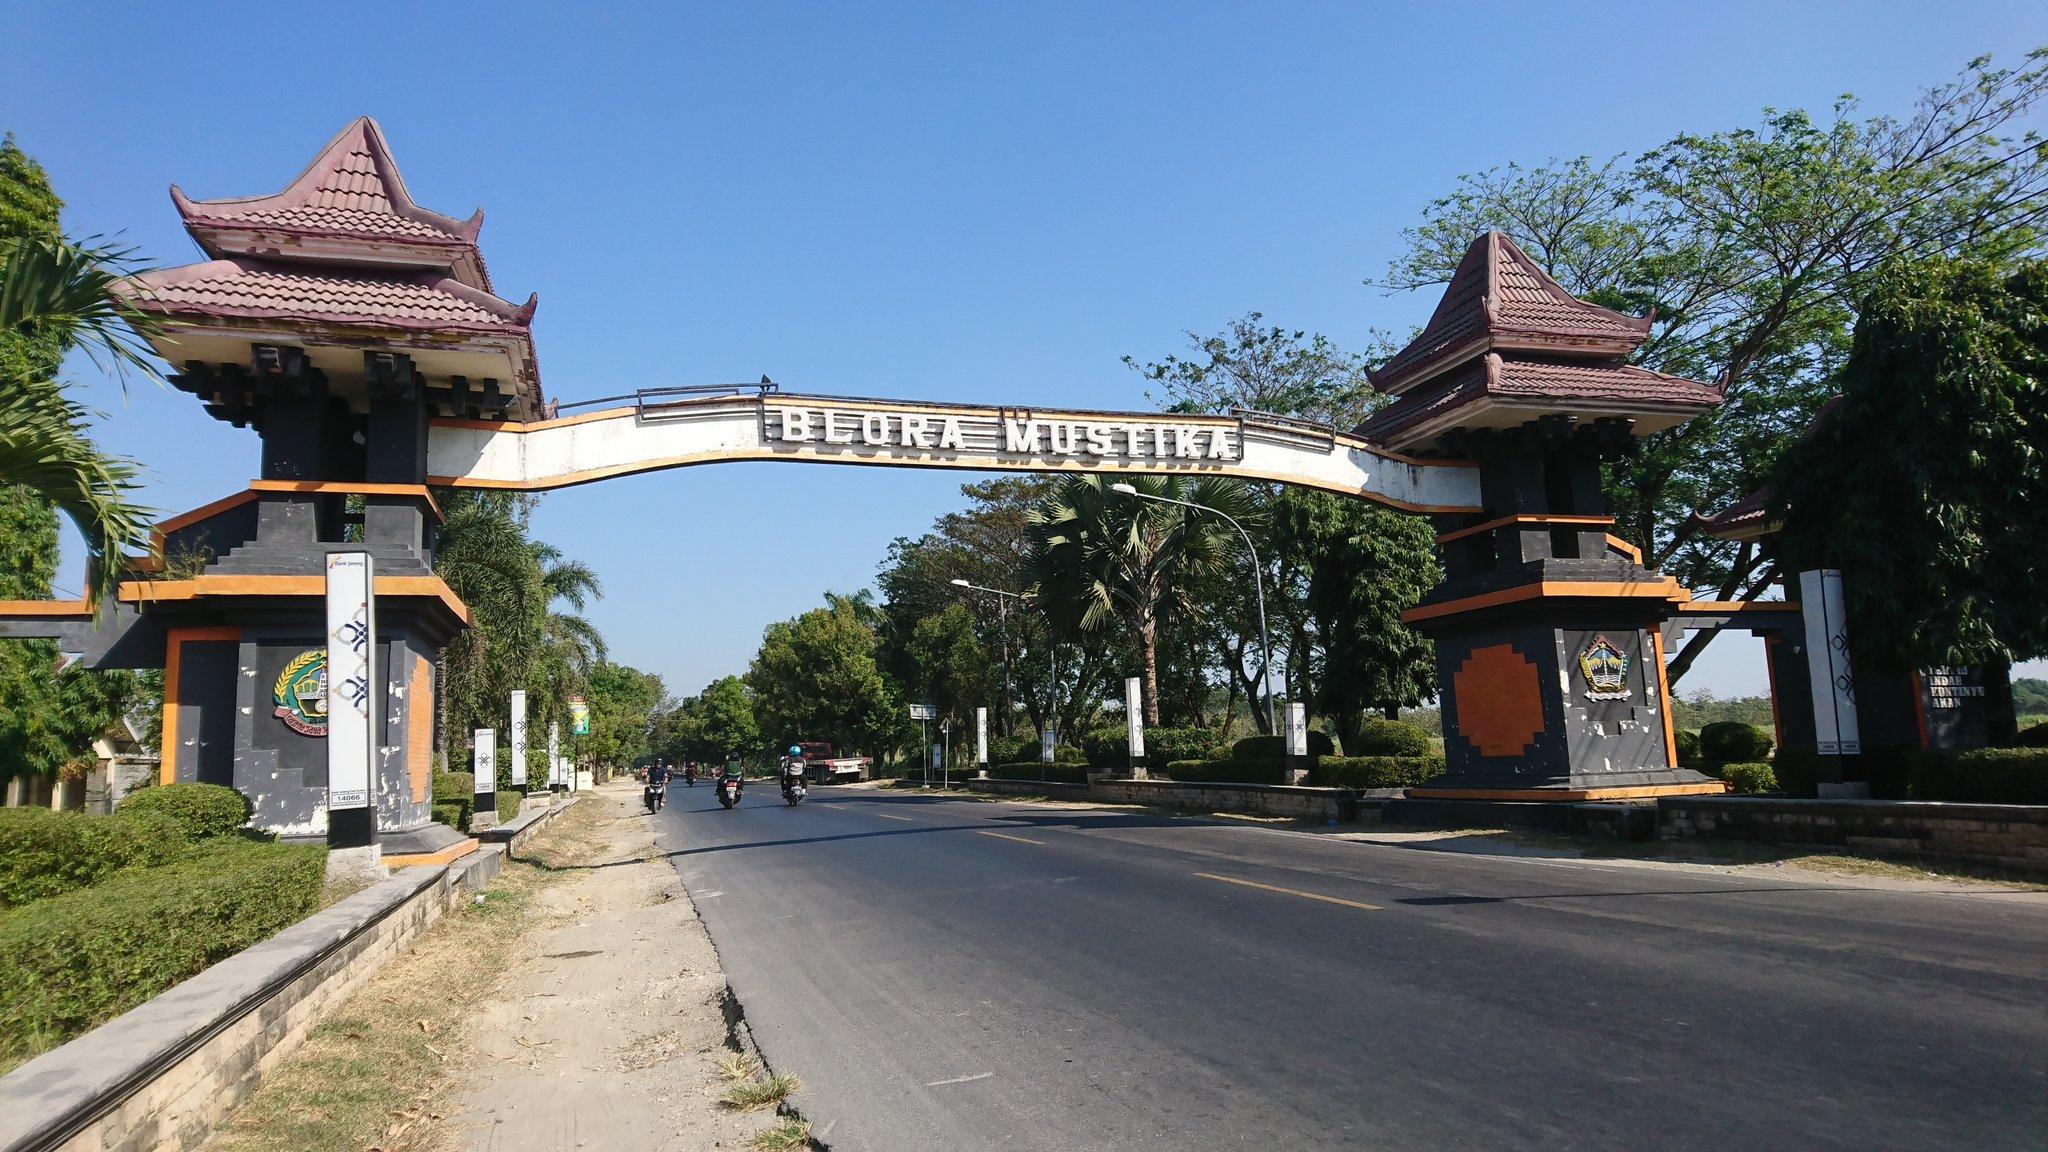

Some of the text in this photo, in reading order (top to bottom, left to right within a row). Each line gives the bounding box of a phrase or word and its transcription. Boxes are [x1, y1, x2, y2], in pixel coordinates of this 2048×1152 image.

[780, 406, 1234, 459] BLORA MUSTIKA
[1930, 675, 1963, 686] INDAH
[1932, 697, 1961, 708] AMAN
[337, 794, 361, 802] 14066
